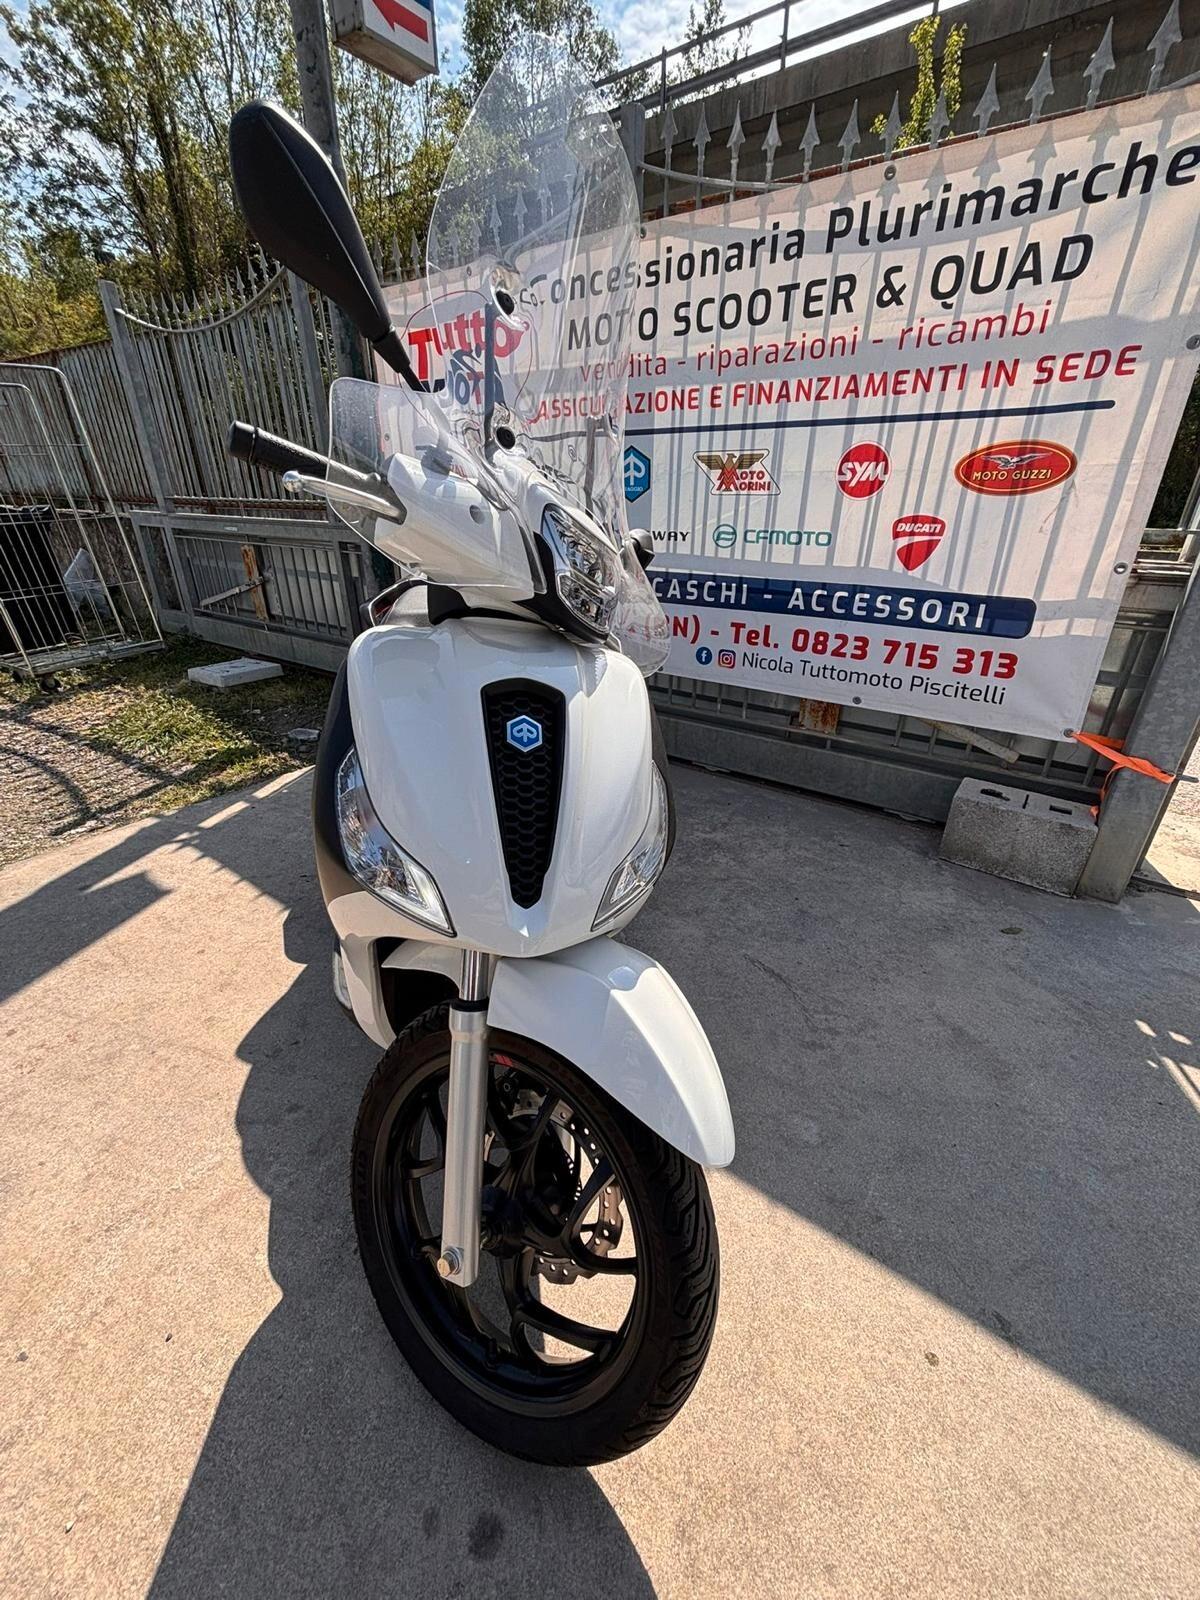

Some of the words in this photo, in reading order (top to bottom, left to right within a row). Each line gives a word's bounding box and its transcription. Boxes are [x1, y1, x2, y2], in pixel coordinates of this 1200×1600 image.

[825, 141, 1200, 254] Plurimarche
[568, 306, 658, 350] MOTO
[673, 273, 857, 337] SCOOTER
[875, 264, 908, 310] &
[930, 233, 1094, 310] QUAD
[580, 352, 667, 382] vendita
[697, 326, 859, 379] riparazioni
[898, 299, 1053, 351] ricambi
[533, 387, 700, 422] ASSICUAZIONE
[709, 386, 724, 408] E
[732, 363, 969, 408] FINANZIAMENTI
[980, 358, 1020, 390] IN
[1032, 345, 1143, 385] SEDE
[836, 461, 888, 488] SYM
[972, 470, 1008, 481] MOTO
[1012, 468, 1052, 480] GUZZI
[652, 530, 690, 542] WAY
[743, 528, 833, 547] CFMOTO
[896, 522, 942, 533] DUCATI
[653, 577, 748, 604] CASCHI
[787, 588, 987, 629] ACCESSORI
[730, 621, 779, 649] Tel.
[791, 628, 870, 661] 0823
[882, 639, 940, 670] 715
[952, 648, 1019, 679] 313
[742, 652, 794, 674] Nicola
[800, 659, 903, 691] Tuttomoto
[909, 675, 1006, 705] Piscitelli
